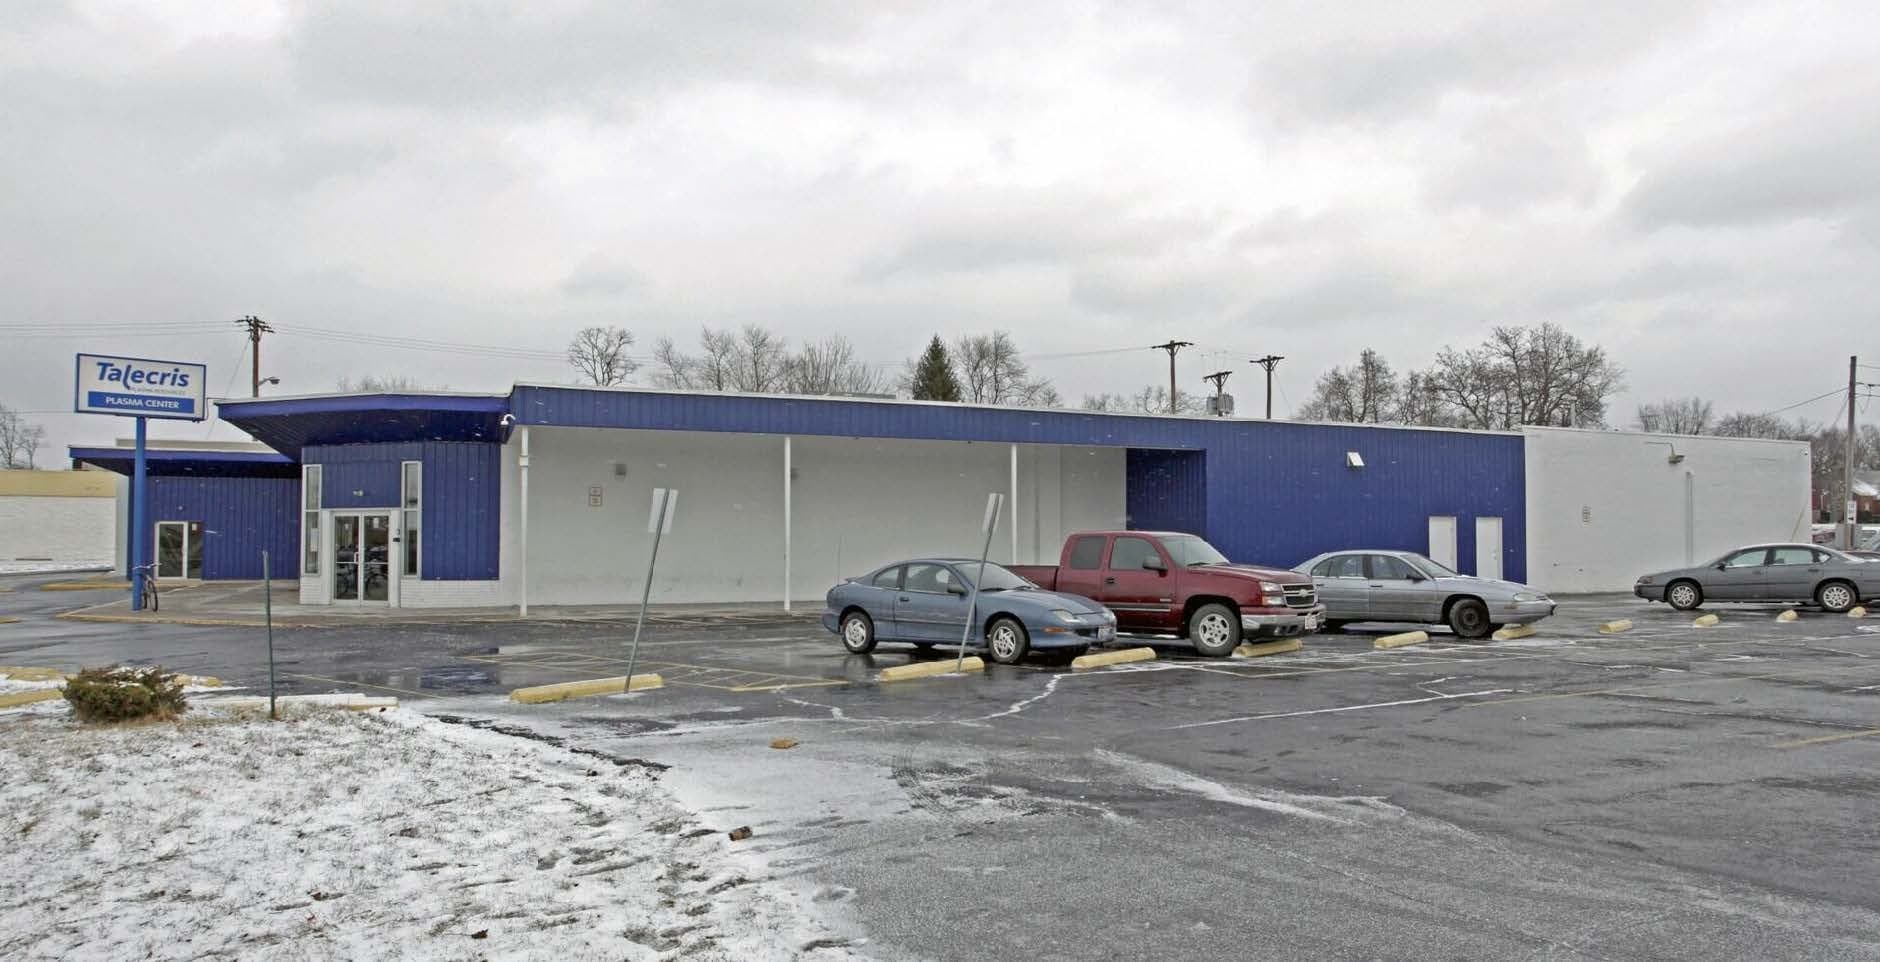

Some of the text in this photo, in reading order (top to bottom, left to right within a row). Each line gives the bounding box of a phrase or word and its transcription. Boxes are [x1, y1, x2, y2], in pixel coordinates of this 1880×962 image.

[96, 362, 189, 390] Talecris
[105, 396, 180, 409] PLASMA CENTER
